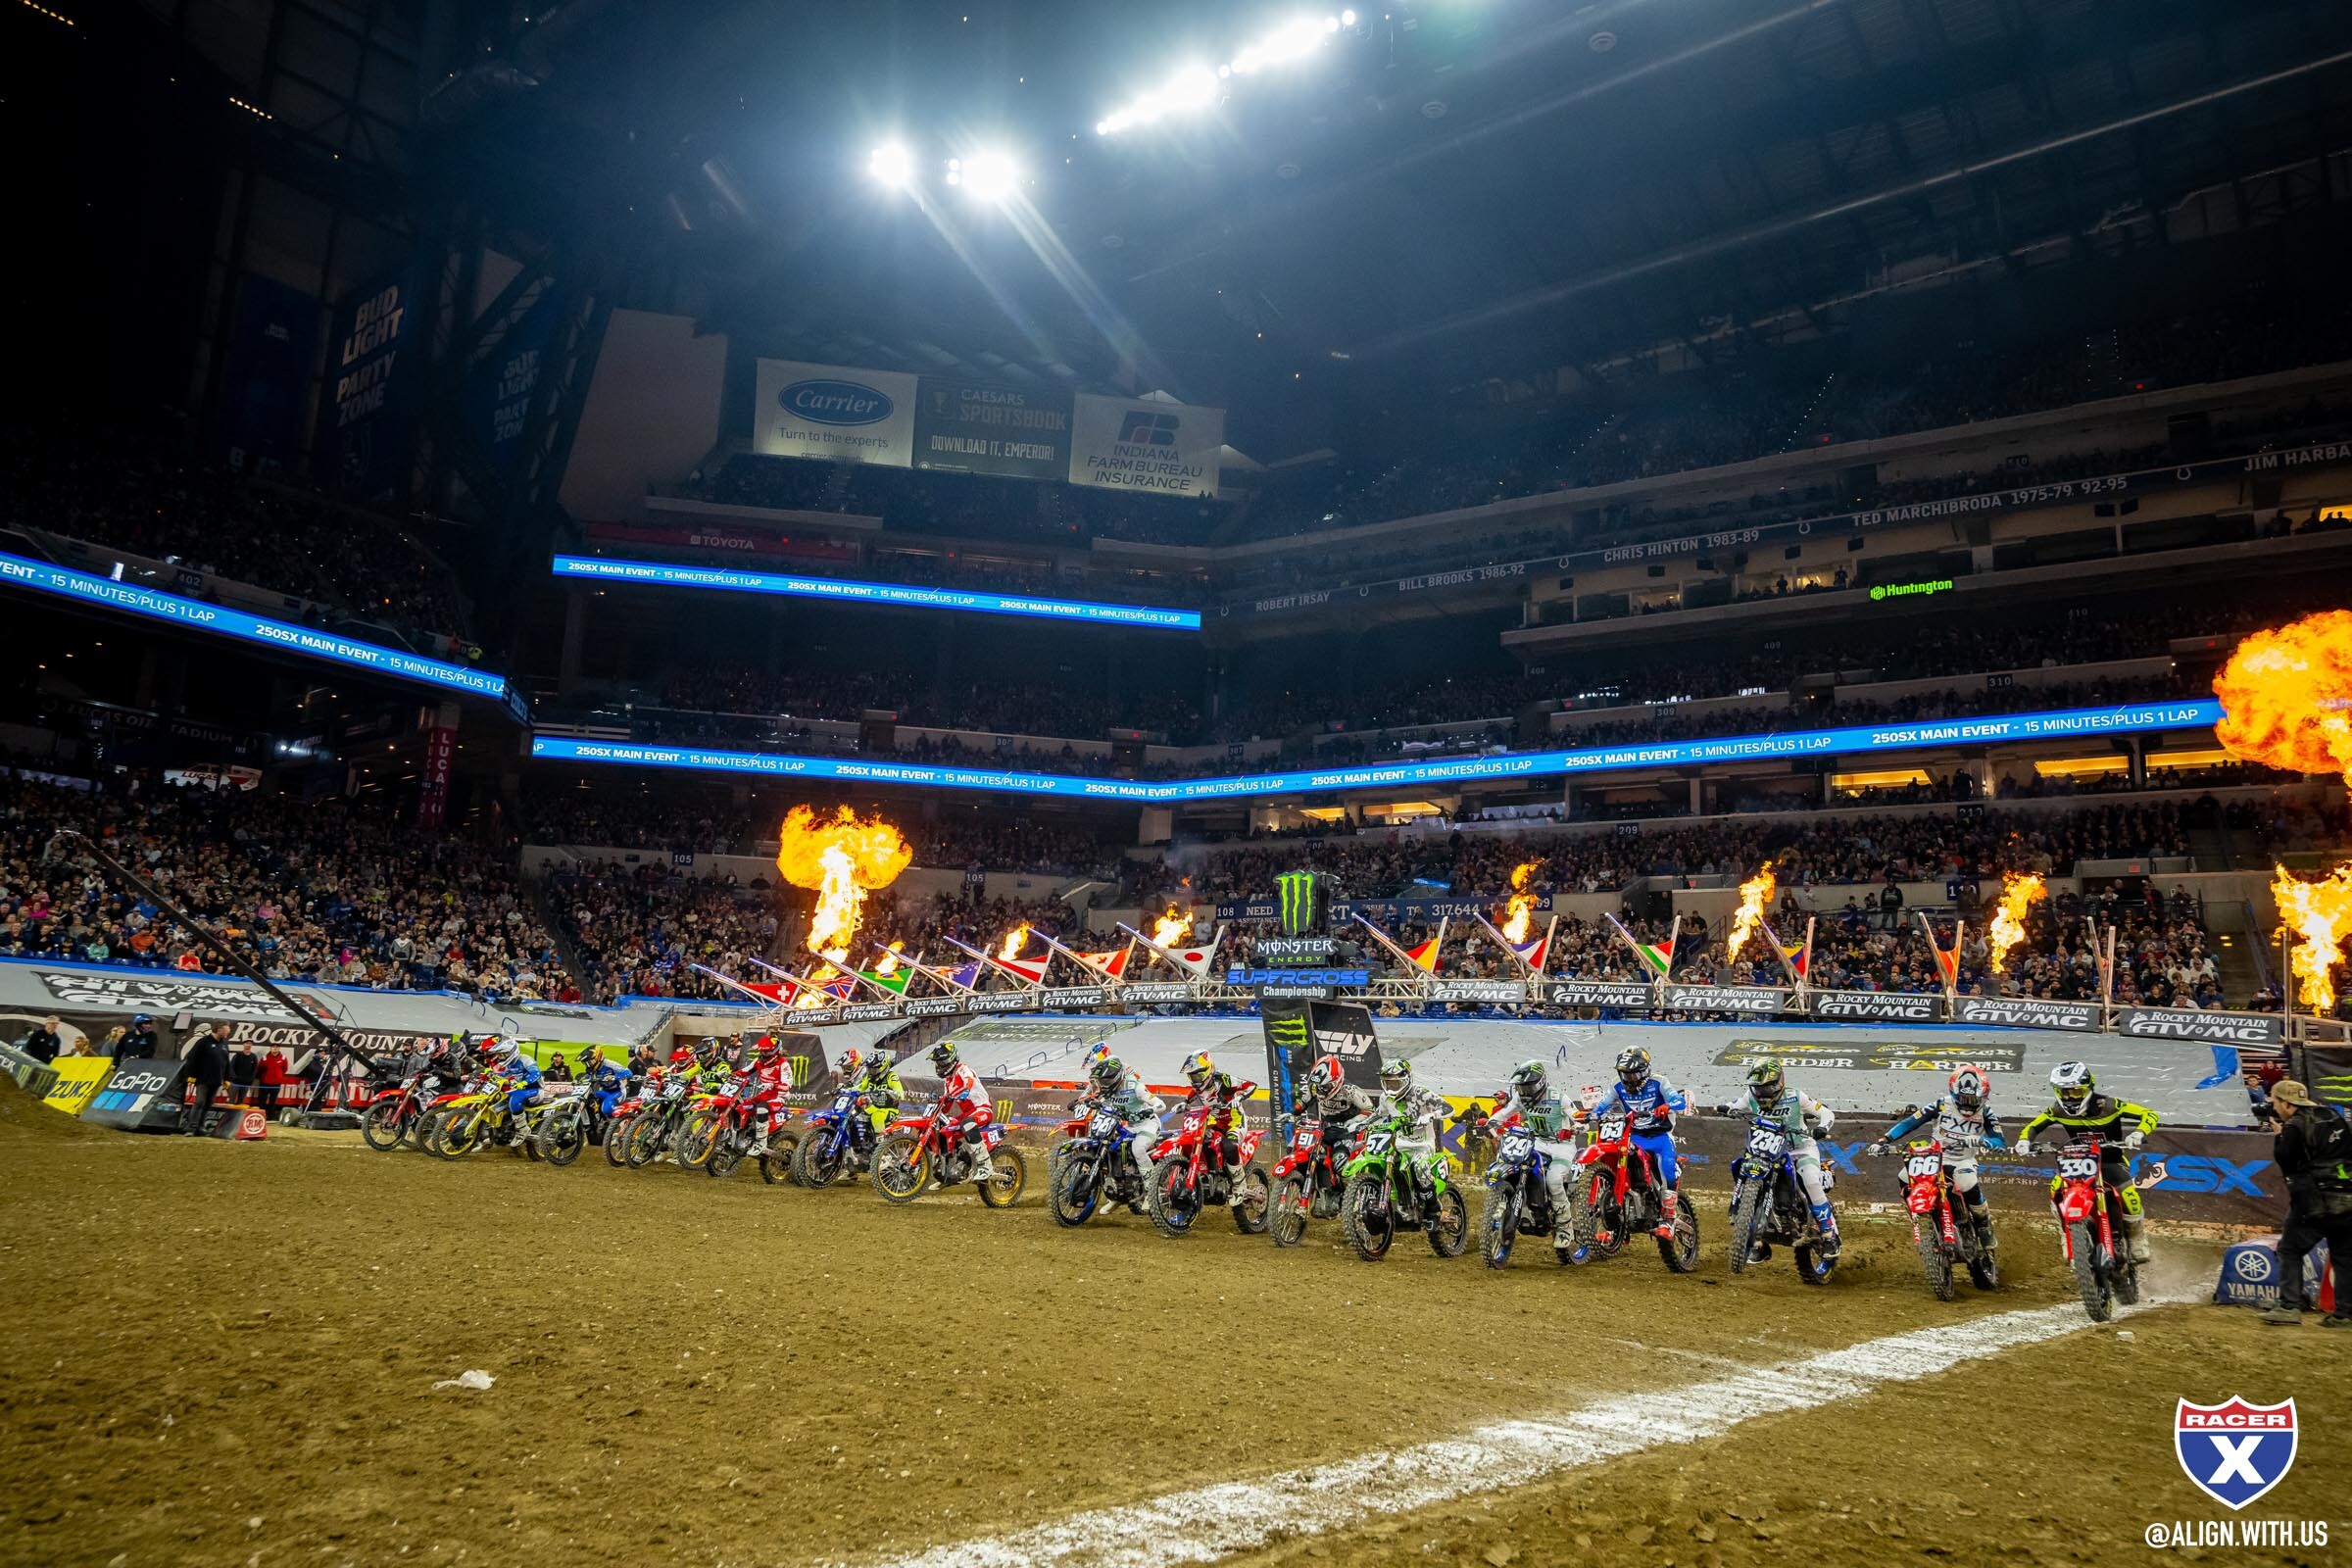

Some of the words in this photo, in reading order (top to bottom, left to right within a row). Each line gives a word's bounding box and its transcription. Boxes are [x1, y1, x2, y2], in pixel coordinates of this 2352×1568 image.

[354, 285, 399, 333] BUD
[341, 308, 405, 368] LIGHT
[336, 351, 397, 406] PARTY
[337, 383, 387, 429] ZONE
[796, 390, 879, 414] Carrier
[960, 389, 1025, 406] CAESARS
[959, 403, 1066, 431] SPORTSBOOK
[778, 427, 806, 441] Turn
[809, 431, 819, 442] to
[824, 430, 843, 444] the
[846, 434, 890, 450] experts
[932, 435, 987, 456] DOWNLOAD
[1114, 444, 1179, 463] INDIANA
[2244, 455, 2278, 470] JIM
[1095, 470, 1191, 490] INSURANCE
[1852, 510, 1882, 527] TED
[1886, 496, 2002, 522] MARCHIBRODA
[2081, 477, 2128, 495] 92-95
[703, 535, 755, 550] TOYOTA
[1603, 547, 1643, 564] CHRIS
[1647, 538, 1698, 558] HINTON
[1704, 530, 1759, 549] 1983-89
[179, 568, 201, 586] 402
[568, 563, 598, 573] 250SX
[600, 565, 624, 575] MAIN
[626, 567, 656, 578] EVENT
[663, 570, 673, 580] 15
[675, 571, 738, 586] MINUTES/PLUS
[745, 578, 761, 588] LAP
[1398, 577, 1424, 591] BILL
[1428, 572, 1473, 587] BROOKS
[1480, 564, 1525, 580] 1986-92
[1887, 580, 1952, 596] Huntington
[52, 574, 67, 588] 15
[71, 580, 176, 615] MINUTES/PLUS
[180, 608, 186, 620] 1
[189, 608, 216, 622] LAP
[1255, 594, 1296, 612] ROBERT
[1298, 591, 1330, 607] IRSAY
[1000, 601, 1027, 612] 250SX
[1029, 604, 1052, 613] MAIN
[1054, 606, 1081, 615] EVENT
[1089, 609, 1098, 617] 15
[1100, 610, 1158, 623] MINUTES/PLUS
[1165, 614, 1180, 624] LAP
[256, 624, 299, 645] 250SX
[301, 635, 336, 653] MAIN
[338, 645, 379, 663] EVENT
[390, 658, 402, 668] 15
[404, 662, 483, 690] MINUTES/PLUS
[493, 681, 505, 692] LA
[1989, 676, 2012, 688] 310
[1872, 729, 1918, 744] 250SX
[1921, 727, 1958, 741] MAIN
[1962, 723, 2010, 738] EVENT
[2025, 721, 2039, 733] 15
[2043, 710, 2154, 731] MINUTES/PLUS
[2169, 709, 2199, 723] LAP
[576, 747, 611, 760] 250SX
[613, 750, 642, 762] MAIN
[645, 753, 679, 763] EVENT
[689, 755, 699, 765] 15
[702, 757, 776, 771] MINUTES/PLUS
[785, 761, 804, 772] LAP
[1566, 755, 1602, 767] 250SX
[1605, 752, 1637, 763] MAIN
[1639, 750, 1679, 761] EVENT
[1690, 748, 1702, 759] 15
[1705, 740, 1795, 758] MINUTES/PLUS
[1807, 738, 1831, 749] LAP
[836, 765, 869, 778] 250SX
[872, 768, 899, 780] MAIN
[902, 771, 935, 782] EVENT
[945, 773, 955, 785] 15
[956, 775, 1028, 790] MINUTES/PLUS
[1037, 780, 1055, 791] LAP
[1085, 784, 1116, 795] 250SX
[1119, 787, 1145, 797] MAIN
[1148, 788, 1177, 798] EVENT
[1185, 786, 1195, 796] 15
[1196, 780, 1257, 795] MINUTES/PLUS
[1266, 779, 1283, 789] LAP
[674, 855, 692, 864] 105
[1217, 907, 1235, 917] 108
[1246, 906, 1273, 916] NEED
[1257, 939, 1334, 955] MONSTER
[1225, 970, 1370, 985] SUPERCROSS
[1263, 986, 1326, 999] Championship
[1568, 984, 1597, 993] ROCKY
[1597, 985, 1646, 995] MOUNTAIN
[1723, 989, 1775, 999] MOUNTAIN
[1835, 994, 1871, 1003] ROCKY
[1872, 995, 1932, 1006] MOUNTAIN
[1983, 1000, 2022, 1010] ROCKY
[2023, 1003, 2089, 1015] MOUNTAIN
[2151, 1011, 2195, 1022] ROCKY
[2196, 1014, 2270, 1028] MOUNTAIN
[229, 1022, 318, 1047] ROCKY
[1314, 1030, 1375, 1055] FLY
[109, 1071, 167, 1092] GoPro
[721, 1085, 739, 1097] 62
[836, 1098, 850, 1110] 6
[1028, 1102, 1061, 1112] MONSTER
[1109, 1097, 1131, 1105] THOR
[1526, 1106, 1552, 1115] THOR
[776, 1112, 787, 1123] 62
[1758, 1106, 1791, 1117] THOR
[1183, 1117, 1200, 1131] 96
[1599, 1122, 1625, 1141] 63
[1940, 1117, 1983, 1134] FXR
[1241, 1142, 1256, 1156] 96
[1298, 1132, 1315, 1147] 91
[1367, 1133, 1392, 1154] 57
[1503, 1136, 1534, 1156] 29
[1750, 1129, 1787, 1154] 238
[1908, 1155, 1939, 1178] 66
[2059, 1158, 2098, 1177] 330
